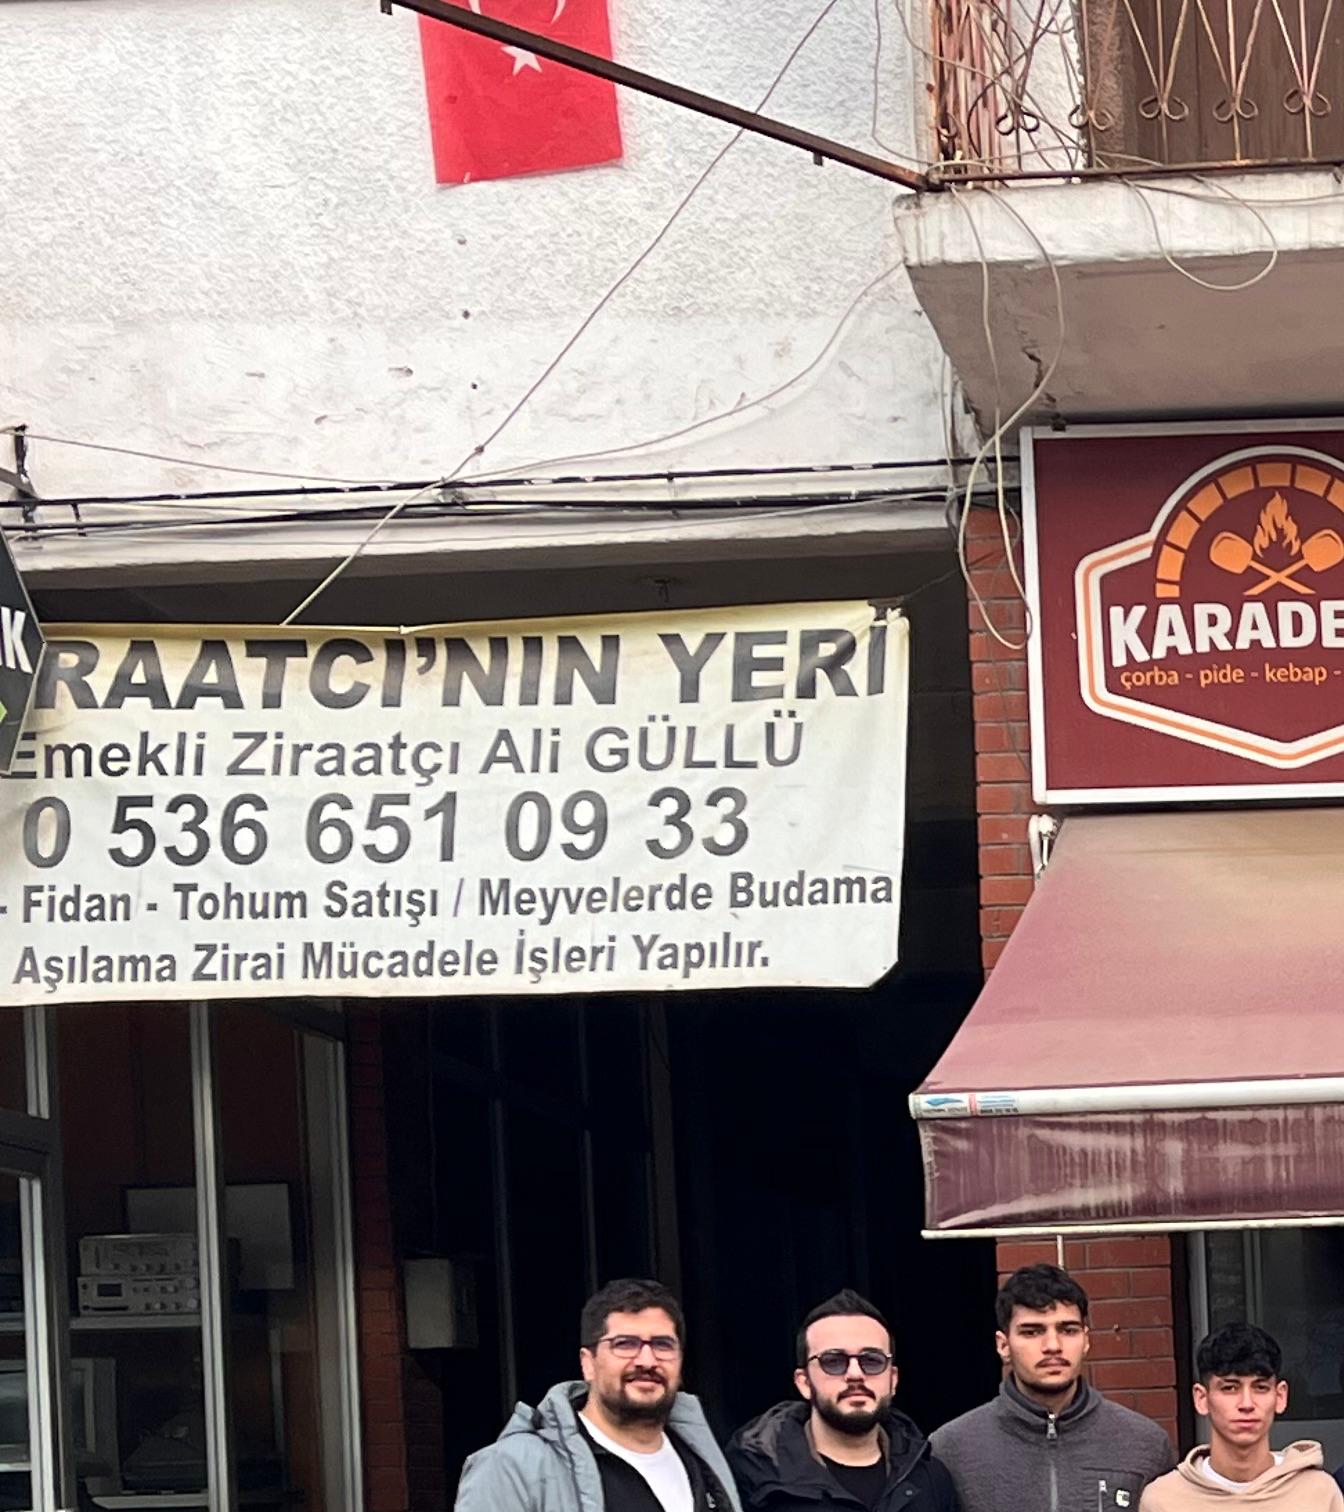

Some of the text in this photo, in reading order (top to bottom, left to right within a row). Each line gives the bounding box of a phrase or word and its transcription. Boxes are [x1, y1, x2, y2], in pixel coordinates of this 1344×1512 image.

[34, 634, 620, 710] RAATCI'NIN
[1120, 666, 1179, 690] çorba
[1200, 663, 1245, 688] pide
[1264, 662, 1328, 685] kebap
[1, 709, 804, 787] Emekli Ziraatçı Ali GÜLLÜ
[23, 787, 749, 869] 0 536 651 09 33
[22, 884, 131, 923] Fidan
[173, 882, 307, 922] Tohum
[323, 879, 438, 927] Satışı
[479, 873, 713, 926] Meyvelerde
[729, 869, 893, 908] Budama
[12, 929, 769, 993] Aşılama Zirai Mücadele İşleri Yapılır.
